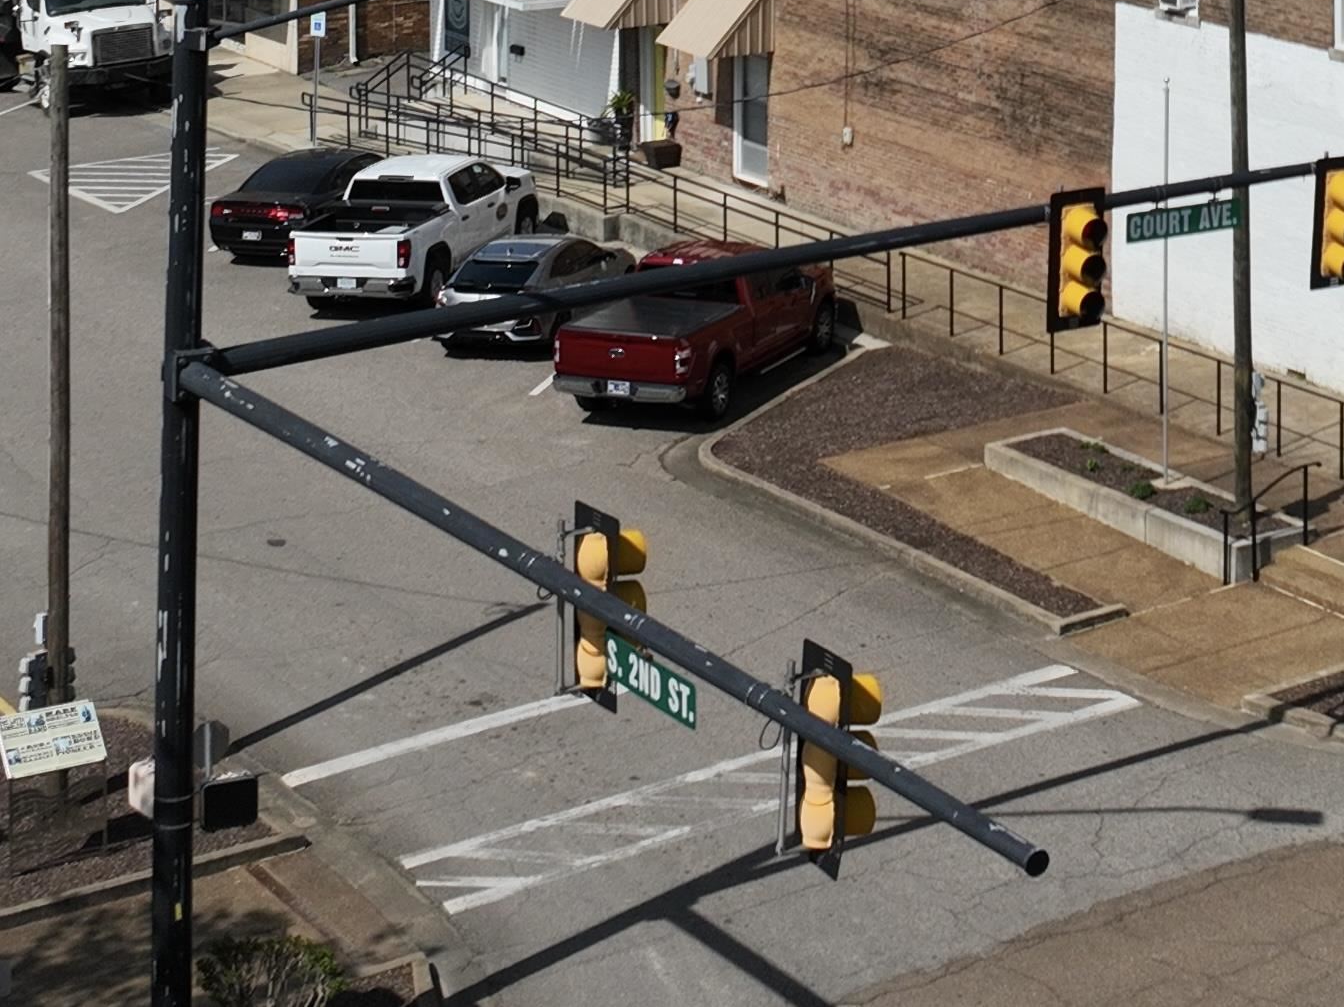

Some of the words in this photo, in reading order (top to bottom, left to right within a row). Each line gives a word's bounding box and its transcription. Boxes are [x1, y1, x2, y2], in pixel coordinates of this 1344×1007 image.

[1129, 208, 1192, 239] COURT
[1199, 202, 1238, 230] AVE.
[607, 638, 623, 678] S.
[628, 652, 661, 701] 2ND
[668, 676, 695, 723] ST.
